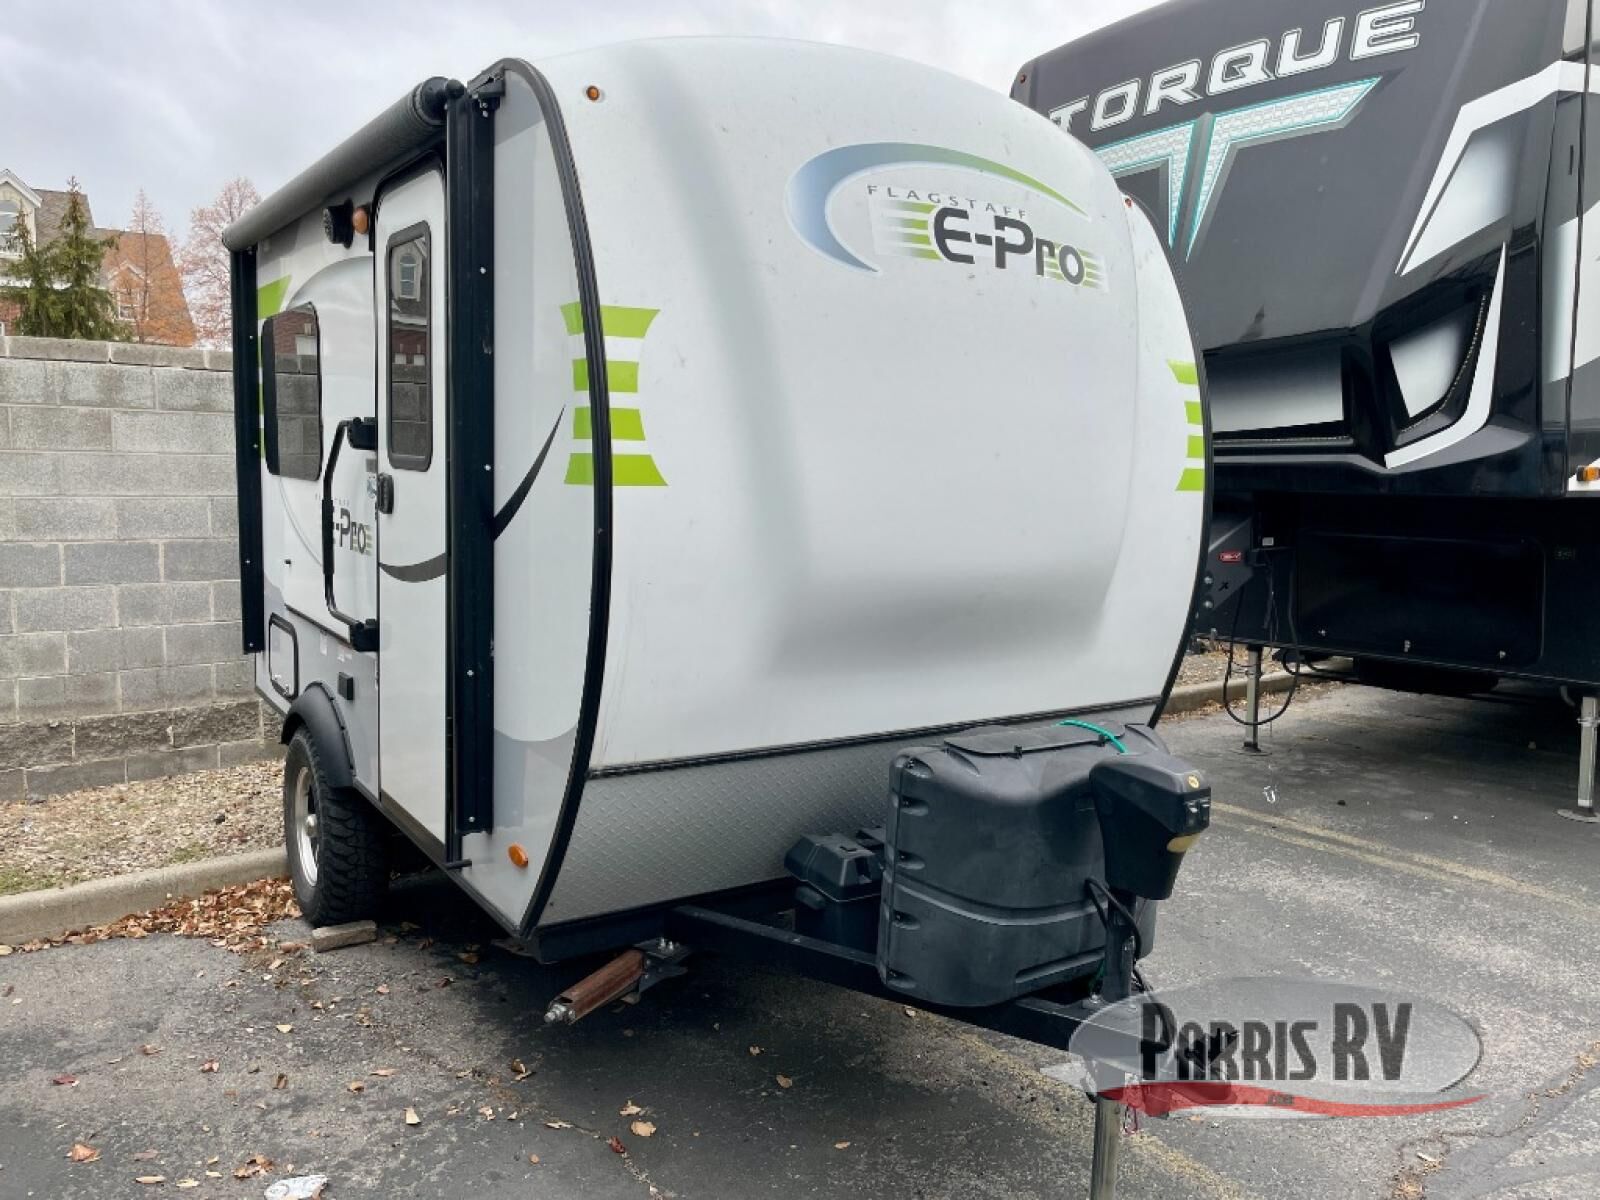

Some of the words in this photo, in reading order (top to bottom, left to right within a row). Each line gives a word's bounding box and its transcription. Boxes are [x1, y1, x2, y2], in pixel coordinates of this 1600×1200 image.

[1047, 0, 1425, 132] TORQUE
[866, 184, 1027, 220] FLAGSTAFF
[333, 507, 367, 553] -Pro
